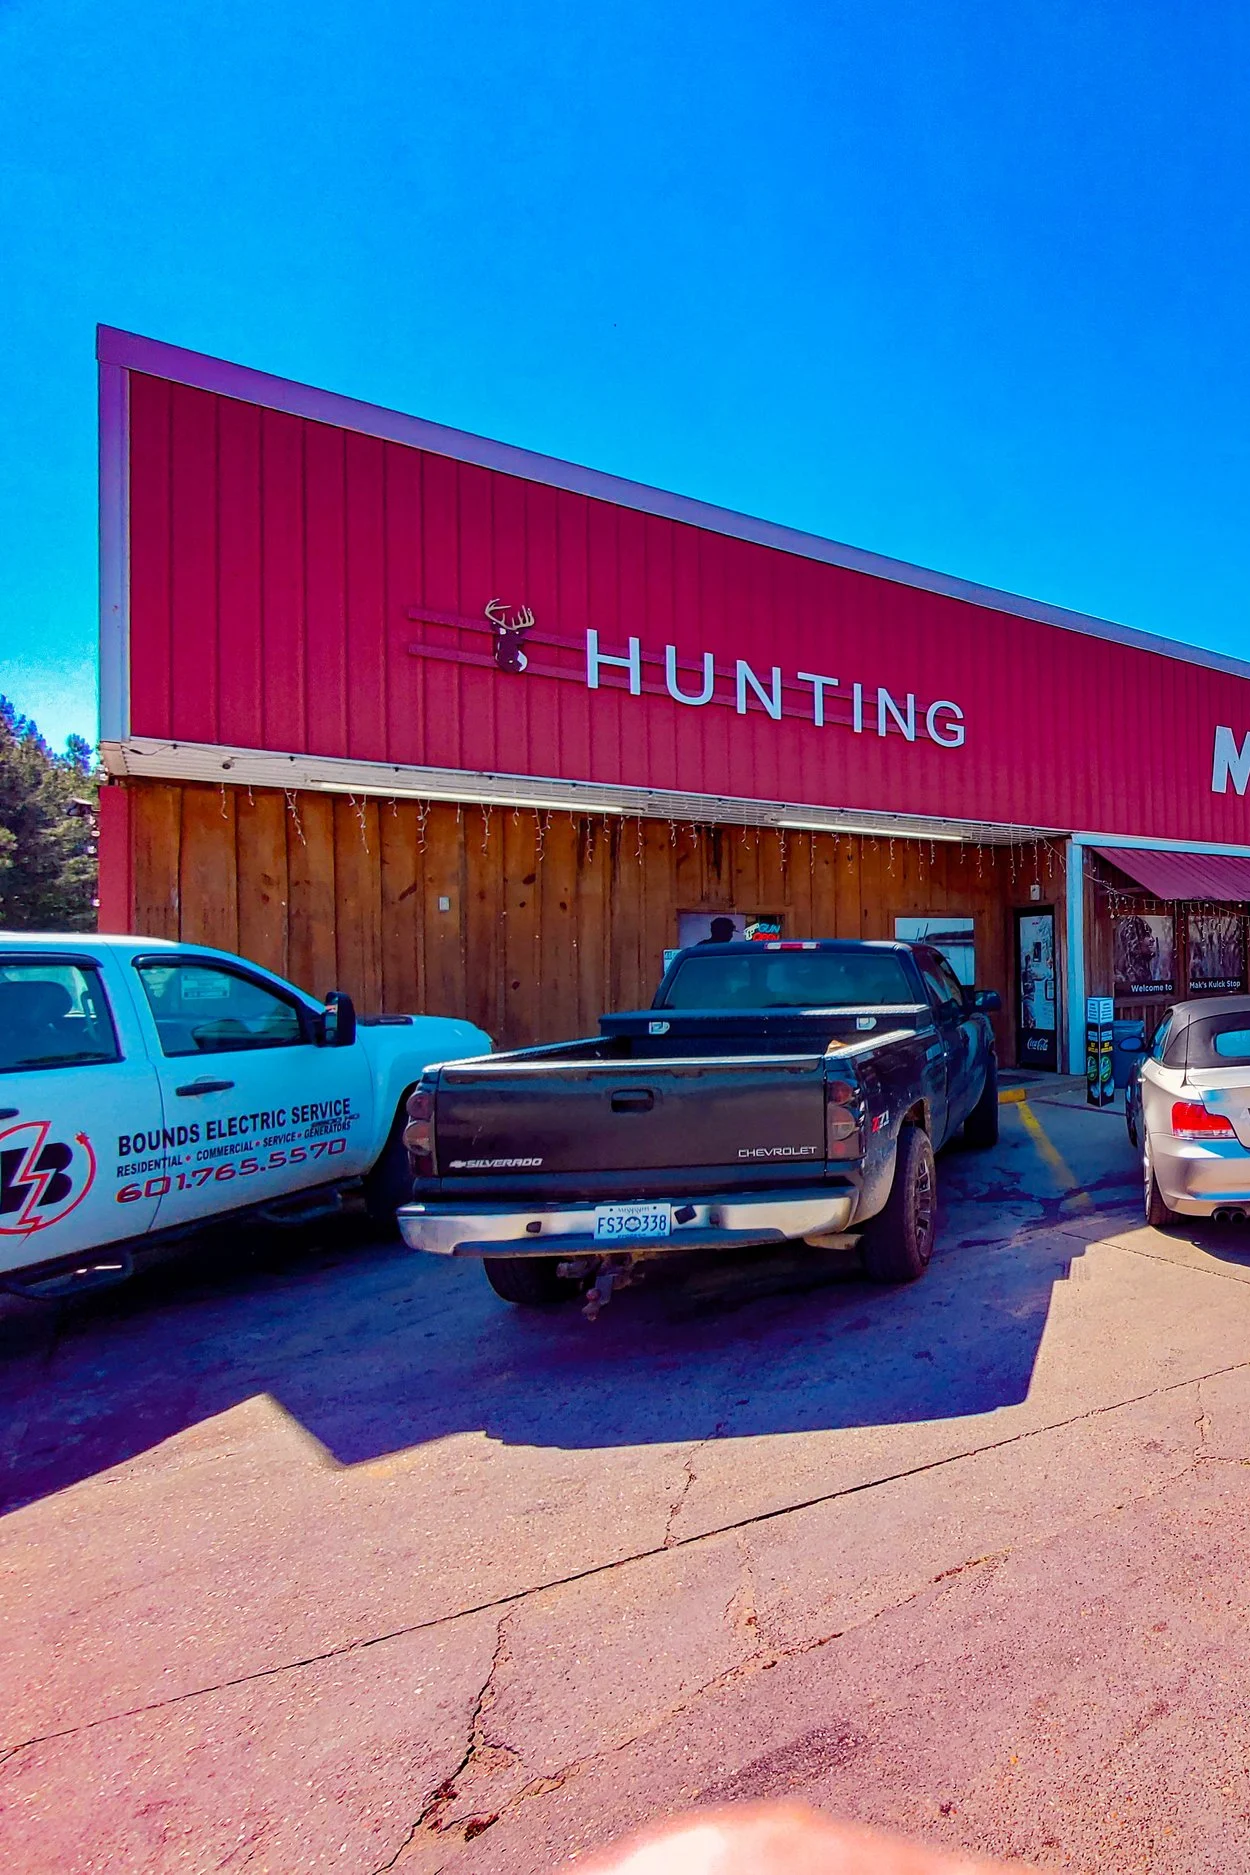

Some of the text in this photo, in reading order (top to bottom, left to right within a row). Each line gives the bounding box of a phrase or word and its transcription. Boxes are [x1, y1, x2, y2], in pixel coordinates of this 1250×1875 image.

[587, 628, 966, 748] HUNTING
[758, 923, 781, 934] GUN
[1131, 983, 1173, 993] Welcome to
[1189, 981, 1208, 989] Mak's
[1226, 980, 1241, 988] Stop
[118, 1097, 351, 1157] BOUNDS ELECTRIC SERVICE
[116, 1155, 183, 1179] RESIDENTIAL
[196, 1141, 254, 1162] COMMERCIAL
[262, 1131, 296, 1148] SERVICE
[304, 1120, 351, 1139] GENERATORS
[738, 1145, 817, 1158] CHEVROLET
[115, 1137, 347, 1204] 601.765.5570
[466, 1158, 543, 1168] SILVERADO
[598, 1214, 667, 1234] FS3 338
